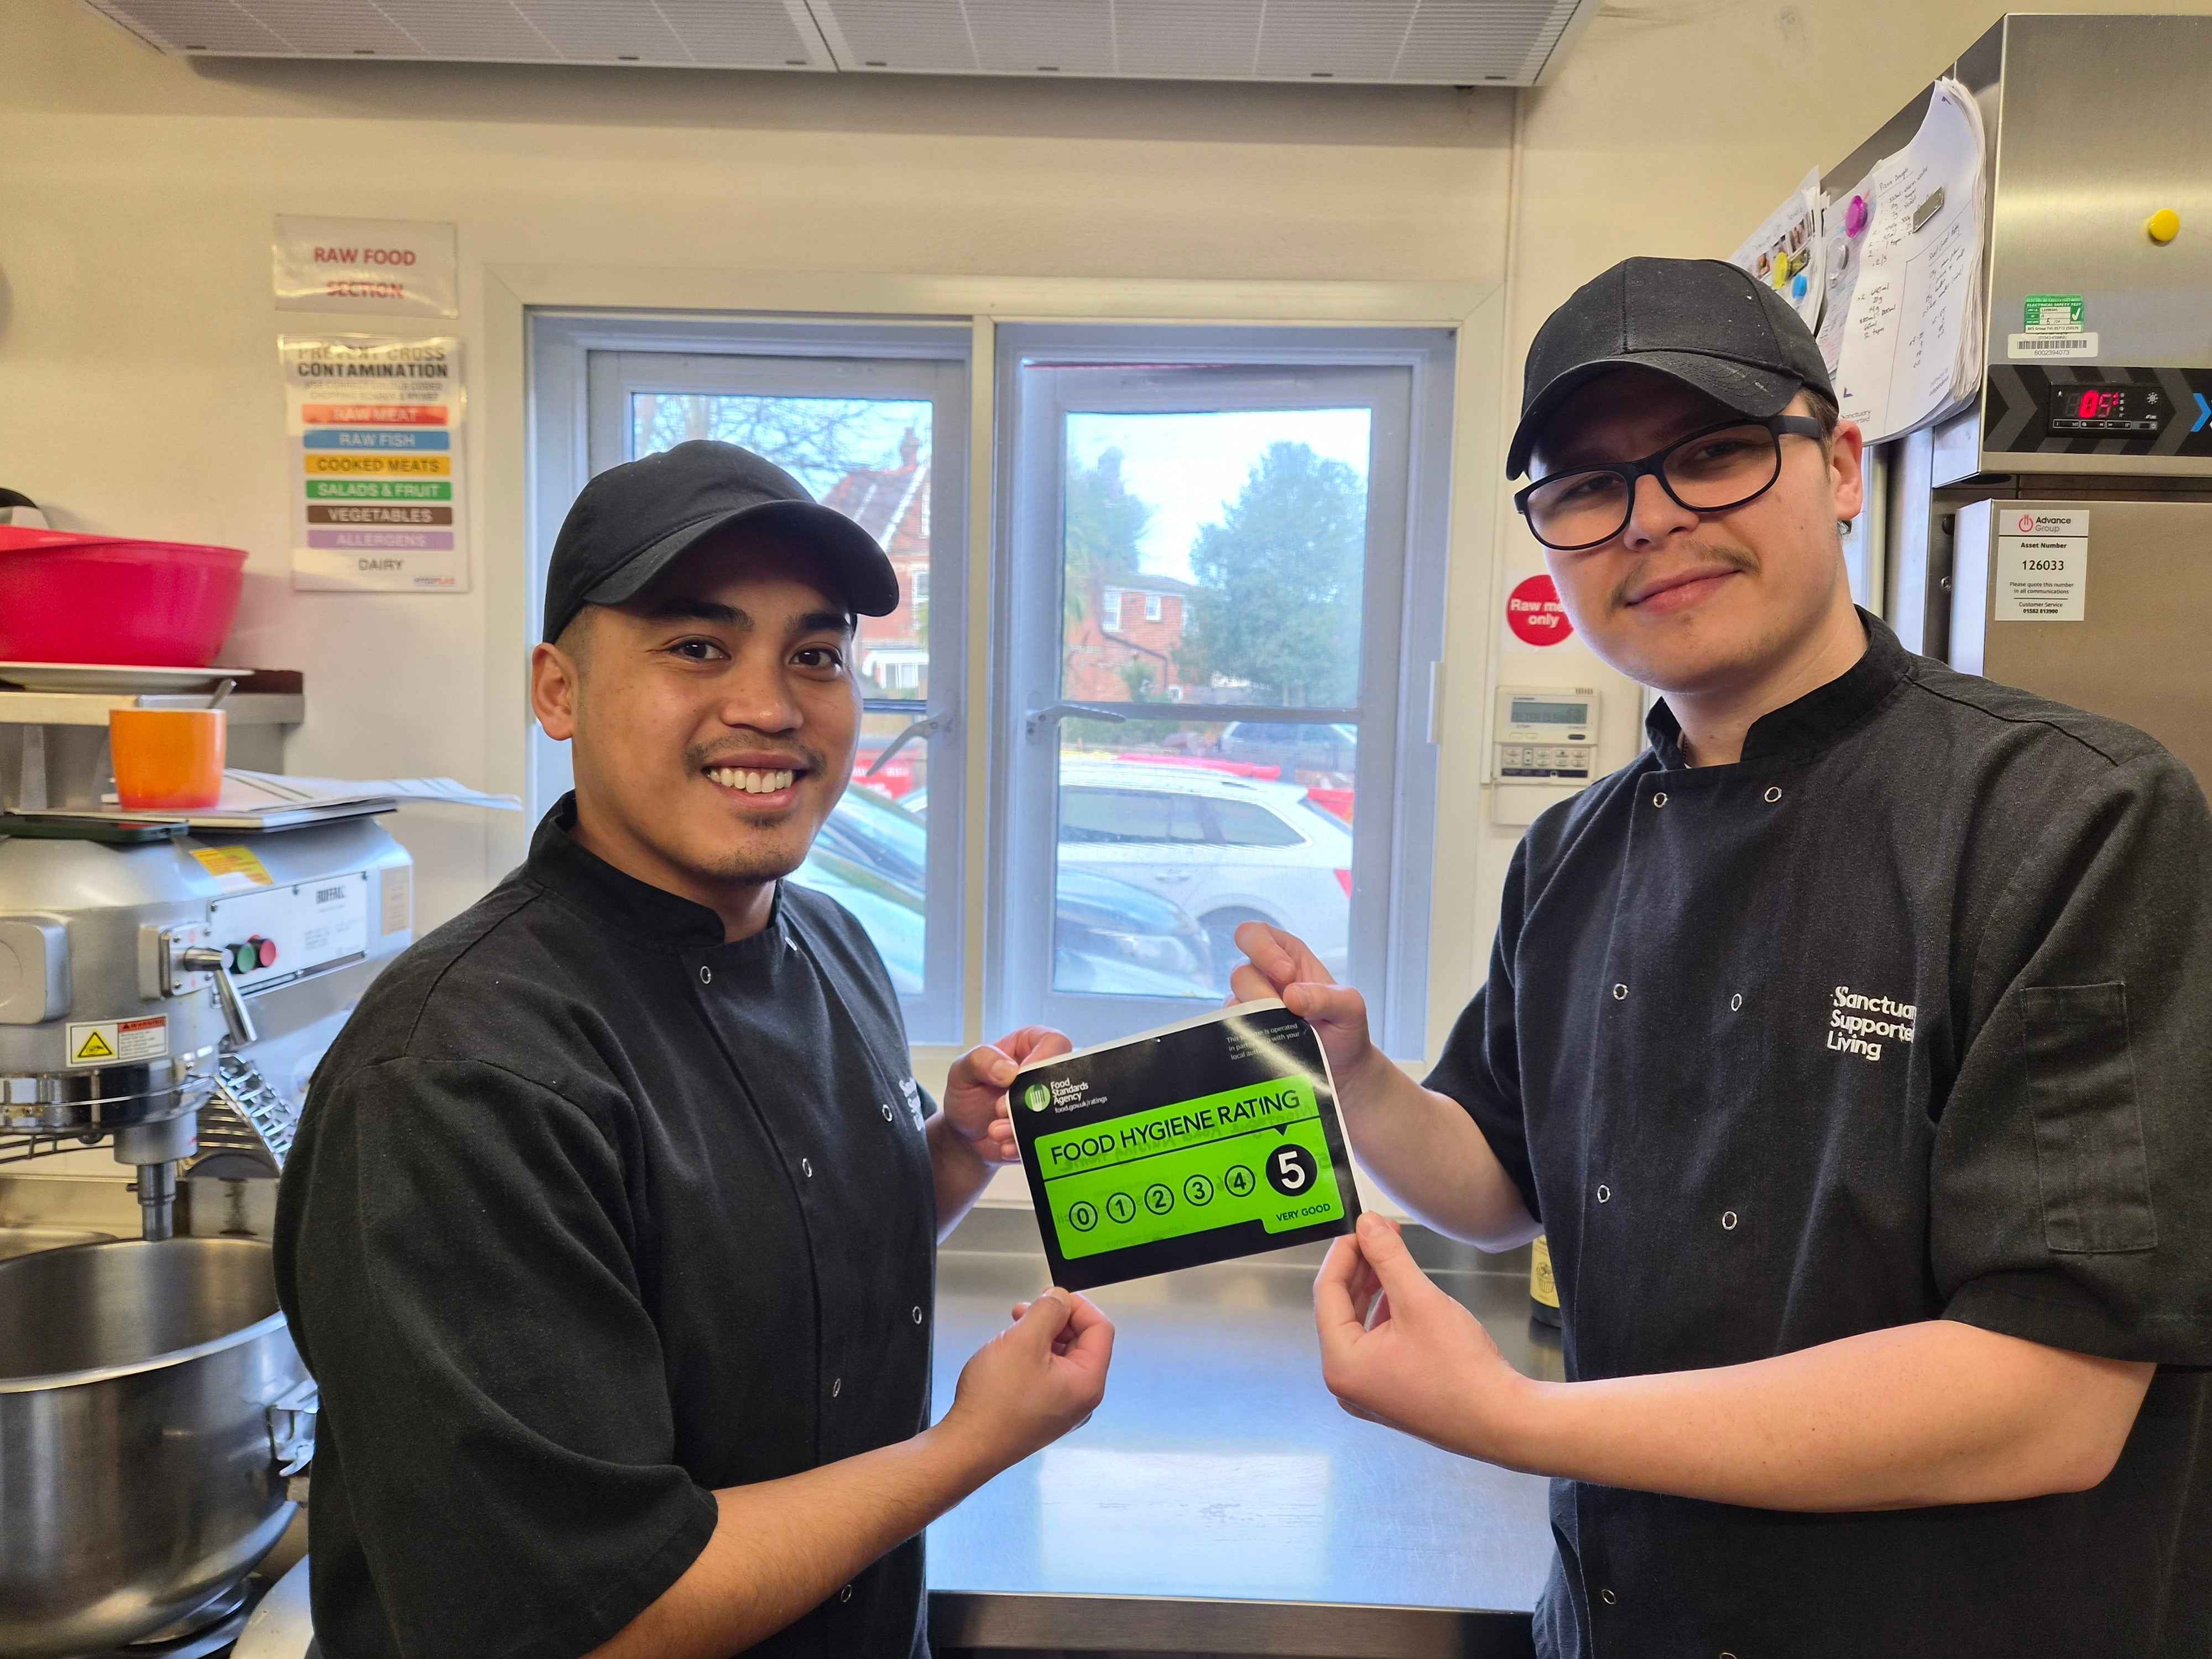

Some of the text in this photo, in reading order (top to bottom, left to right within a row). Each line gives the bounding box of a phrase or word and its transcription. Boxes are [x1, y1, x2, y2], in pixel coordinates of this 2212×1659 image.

[314, 247, 416, 266] RAW FOOD
[326, 281, 404, 298] SECTION
[387, 346, 446, 361] CROSS
[298, 362, 448, 378] CONTAMINATION
[332, 408, 420, 422] RAW MEAT
[339, 433, 415, 447] RAW FISH
[316, 458, 440, 473] COOKED MEATS
[317, 483, 440, 498] SALADS & FRUIT
[328, 507, 434, 523] VEGETABLES
[2036, 525, 2060, 534] Group
[336, 533, 427, 547] ALLERGENS
[358, 558, 404, 571] DAIRY
[2022, 560, 2064, 571] 126033
[1510, 598, 1566, 612] Raw me
[1528, 612, 1560, 628] only
[1270, 1023, 1298, 1035] operated
[1830, 1009, 1916, 1044] Supporte
[1271, 1034, 1286, 1043] with
[1286, 1031, 1300, 1040] your
[1827, 1030, 1882, 1062] Living
[1230, 1051, 1245, 1060] local
[1051, 1077, 1071, 1090] Food
[1052, 1082, 1089, 1098] Standards
[1053, 1092, 1082, 1107] Agency
[1055, 1096, 1108, 1114] food.gov.uk/ratings
[1051, 1089, 1300, 1165] FOOD HYGIENE RATING
[1077, 1207, 1090, 1225] 0
[1115, 1199, 1125, 1217] 1
[1152, 1190, 1167, 1208] 2
[1192, 1181, 1206, 1199] 3
[1233, 1172, 1246, 1190] 4
[1277, 1150, 1306, 1190] 5
[1276, 1203, 1331, 1222] VERY GOOD
